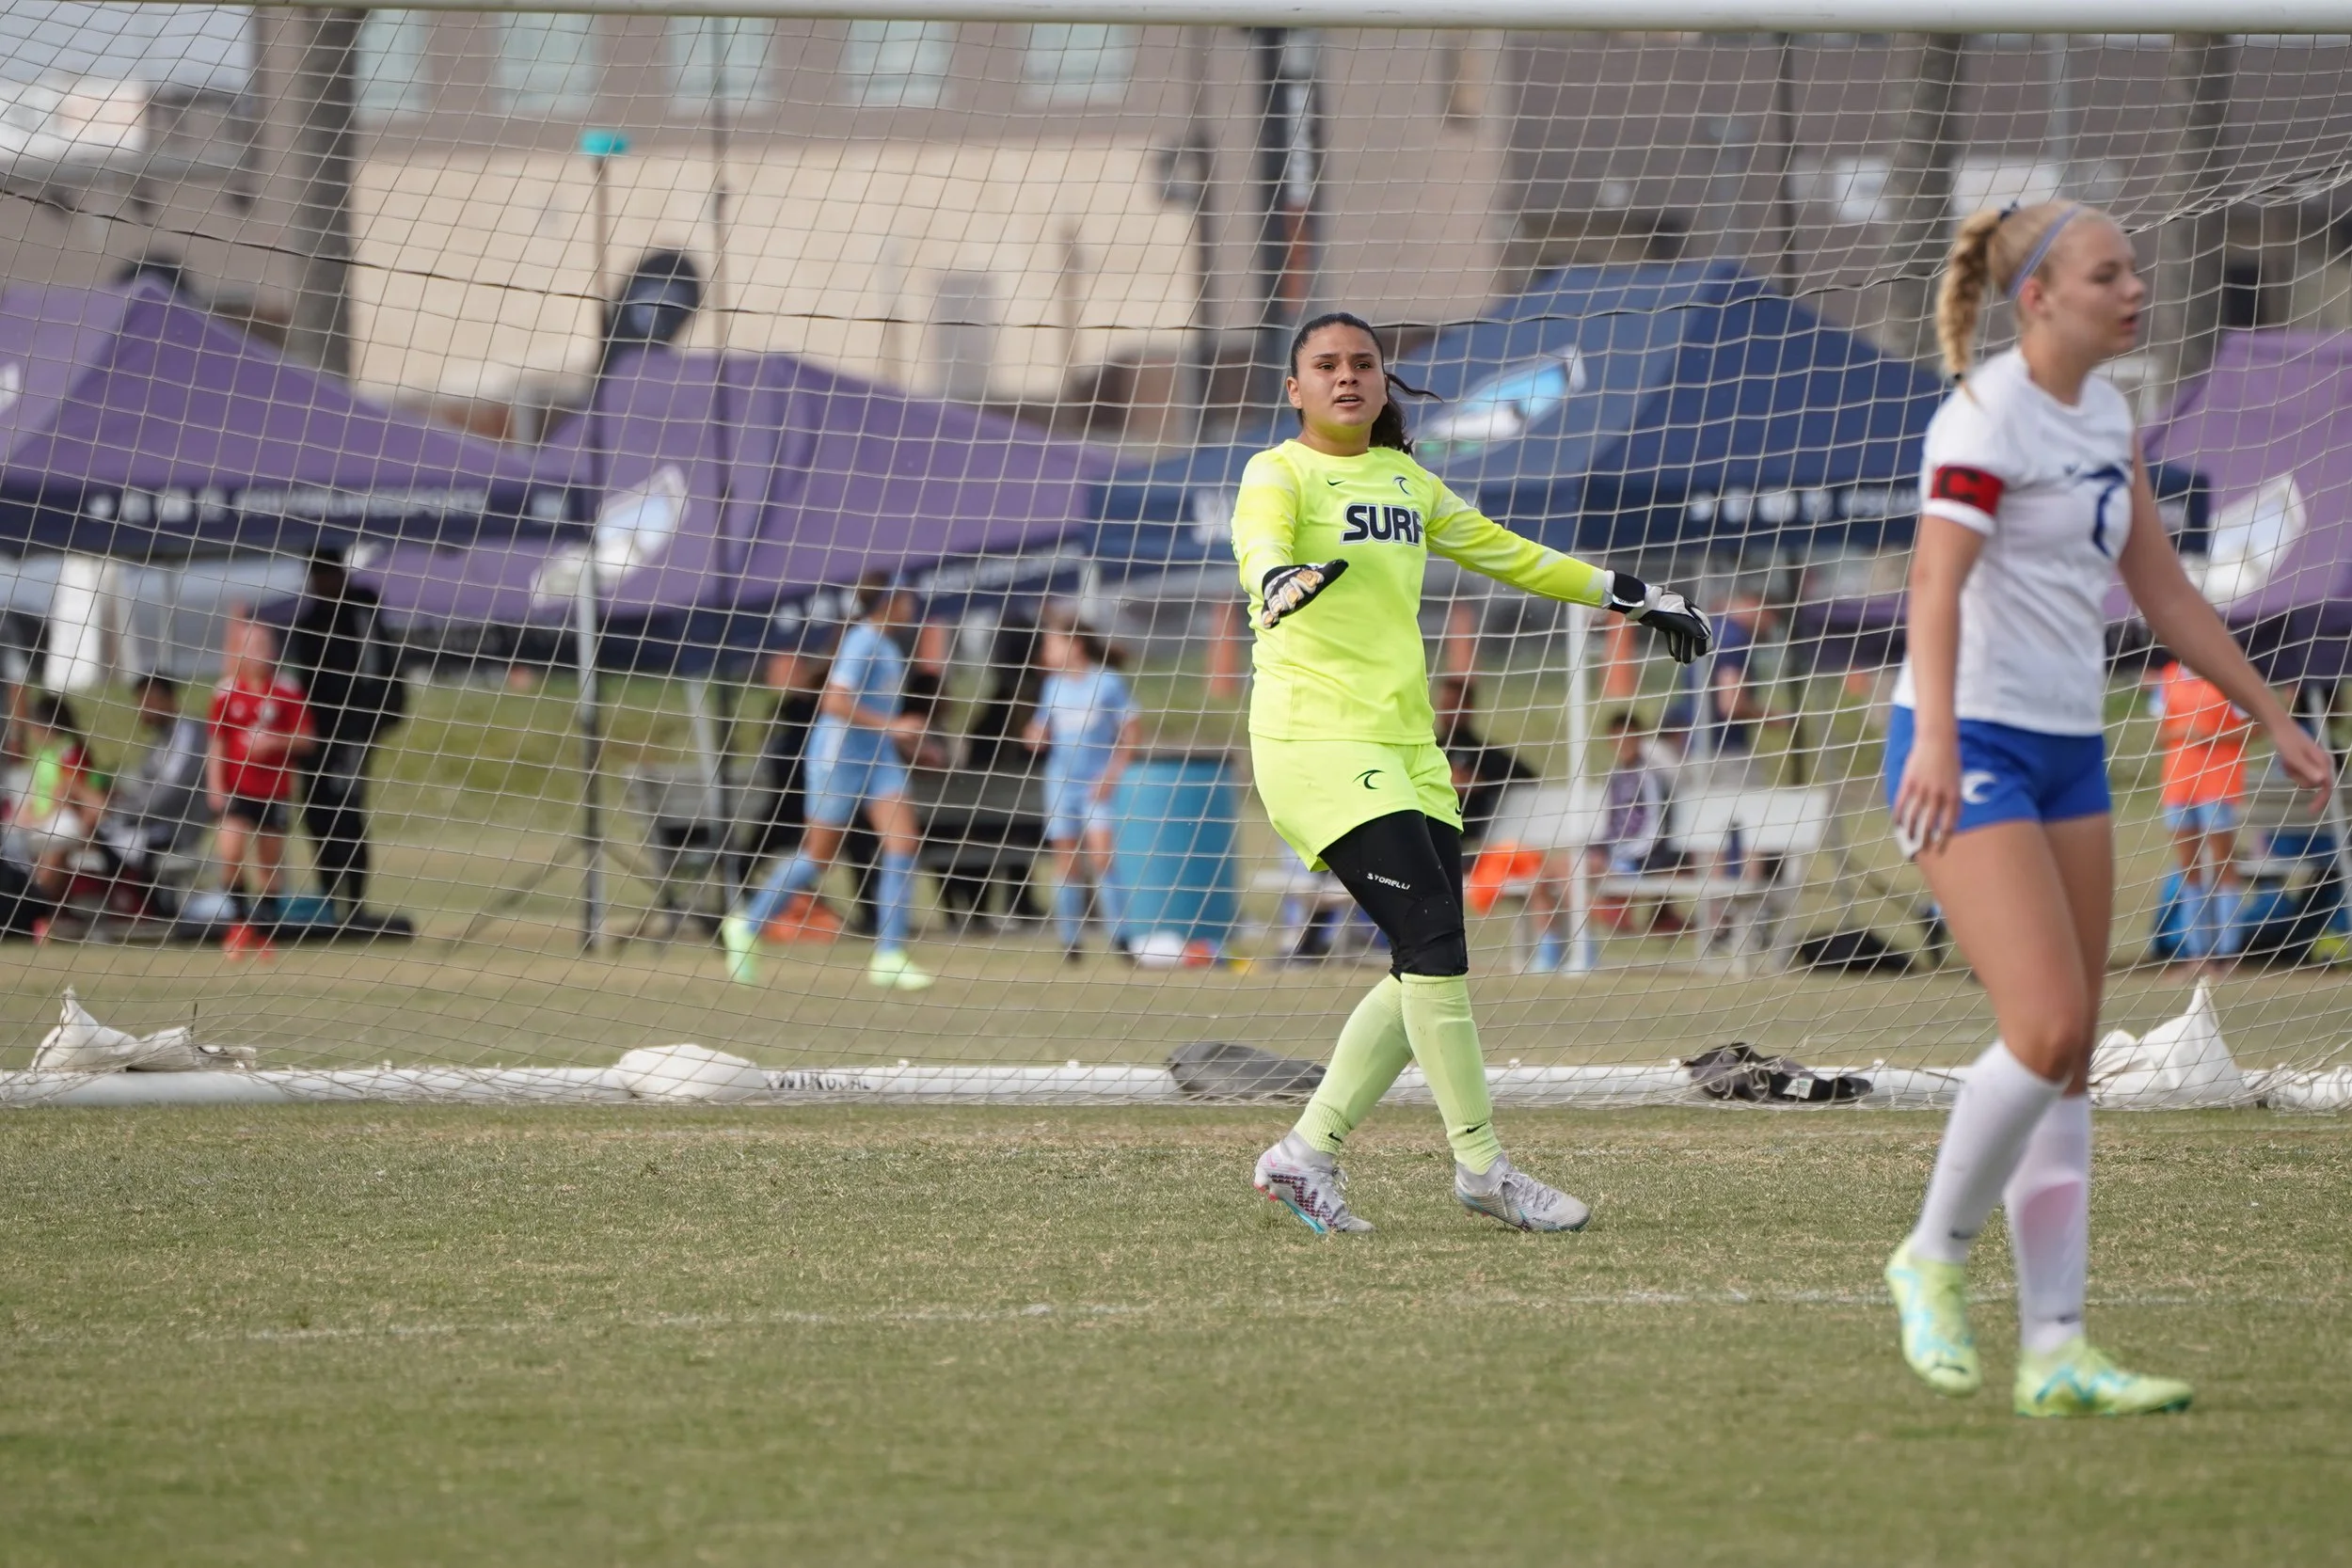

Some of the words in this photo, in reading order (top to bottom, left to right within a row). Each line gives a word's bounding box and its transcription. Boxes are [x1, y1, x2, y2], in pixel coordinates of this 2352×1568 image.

[1939, 467, 1980, 506] C
[1340, 502, 1423, 546] SURF
[1367, 873, 1411, 891] STORELLI
